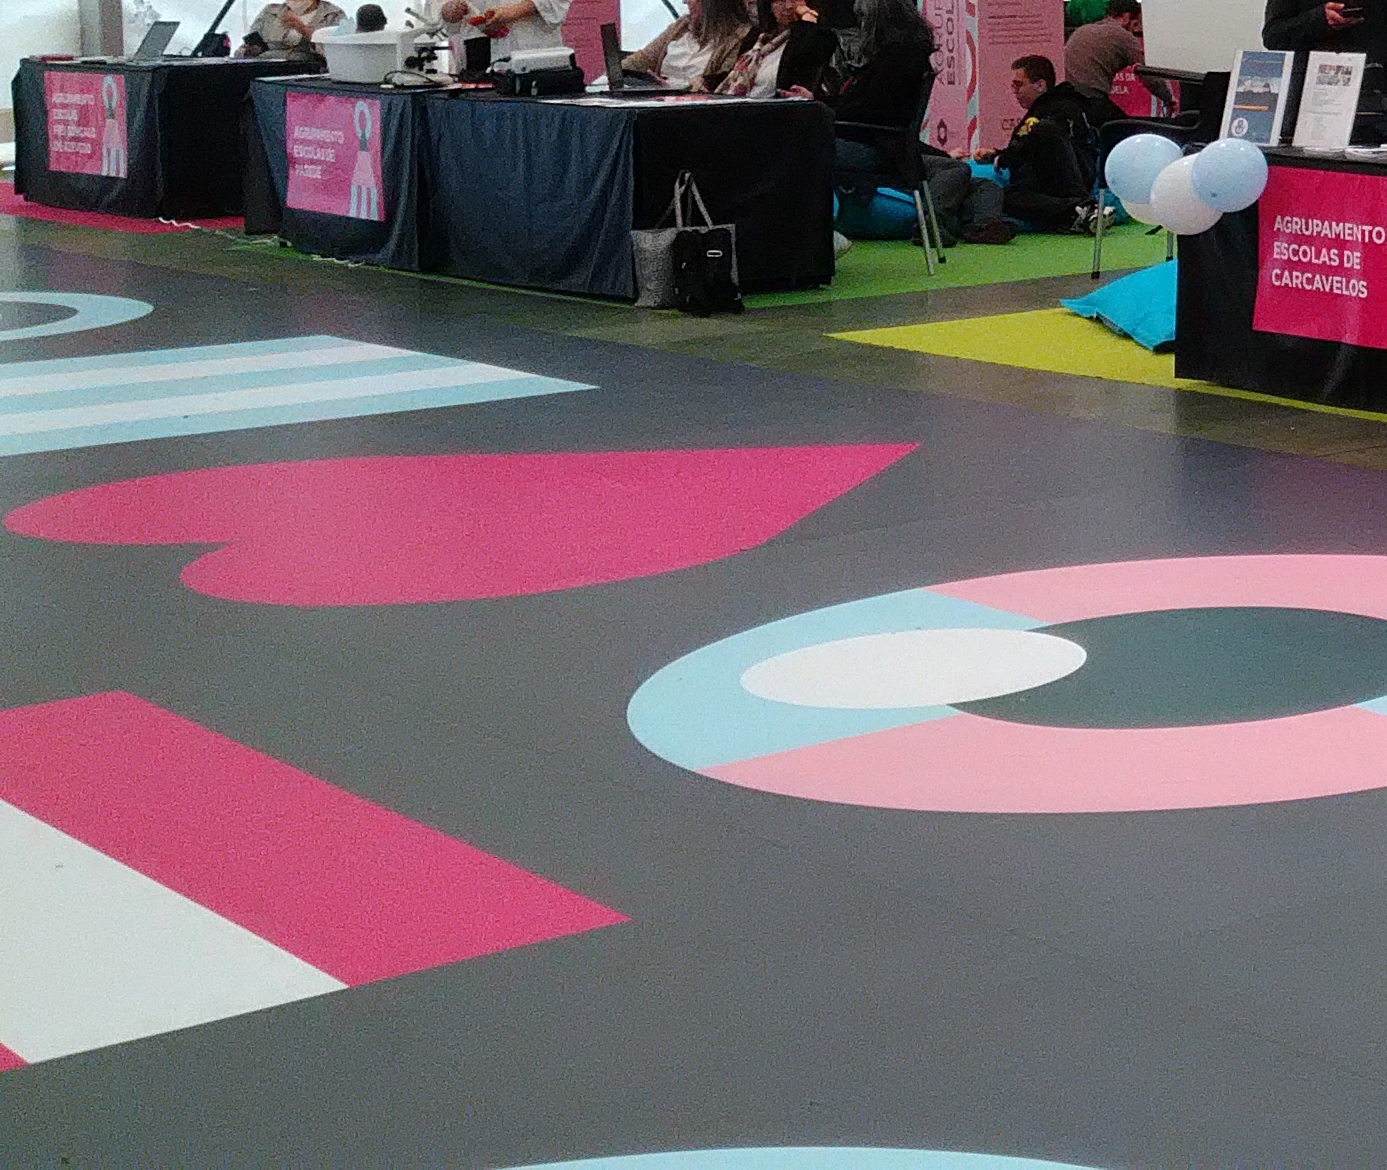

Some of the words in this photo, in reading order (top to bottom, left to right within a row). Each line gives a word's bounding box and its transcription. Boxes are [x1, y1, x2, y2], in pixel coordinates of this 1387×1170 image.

[1273, 215, 1386, 244] AGRUPAMENTO
[1273, 241, 1340, 267] ESCOLAS
[1343, 250, 1361, 270] DE
[1271, 268, 1368, 298] CARCAVELOS
